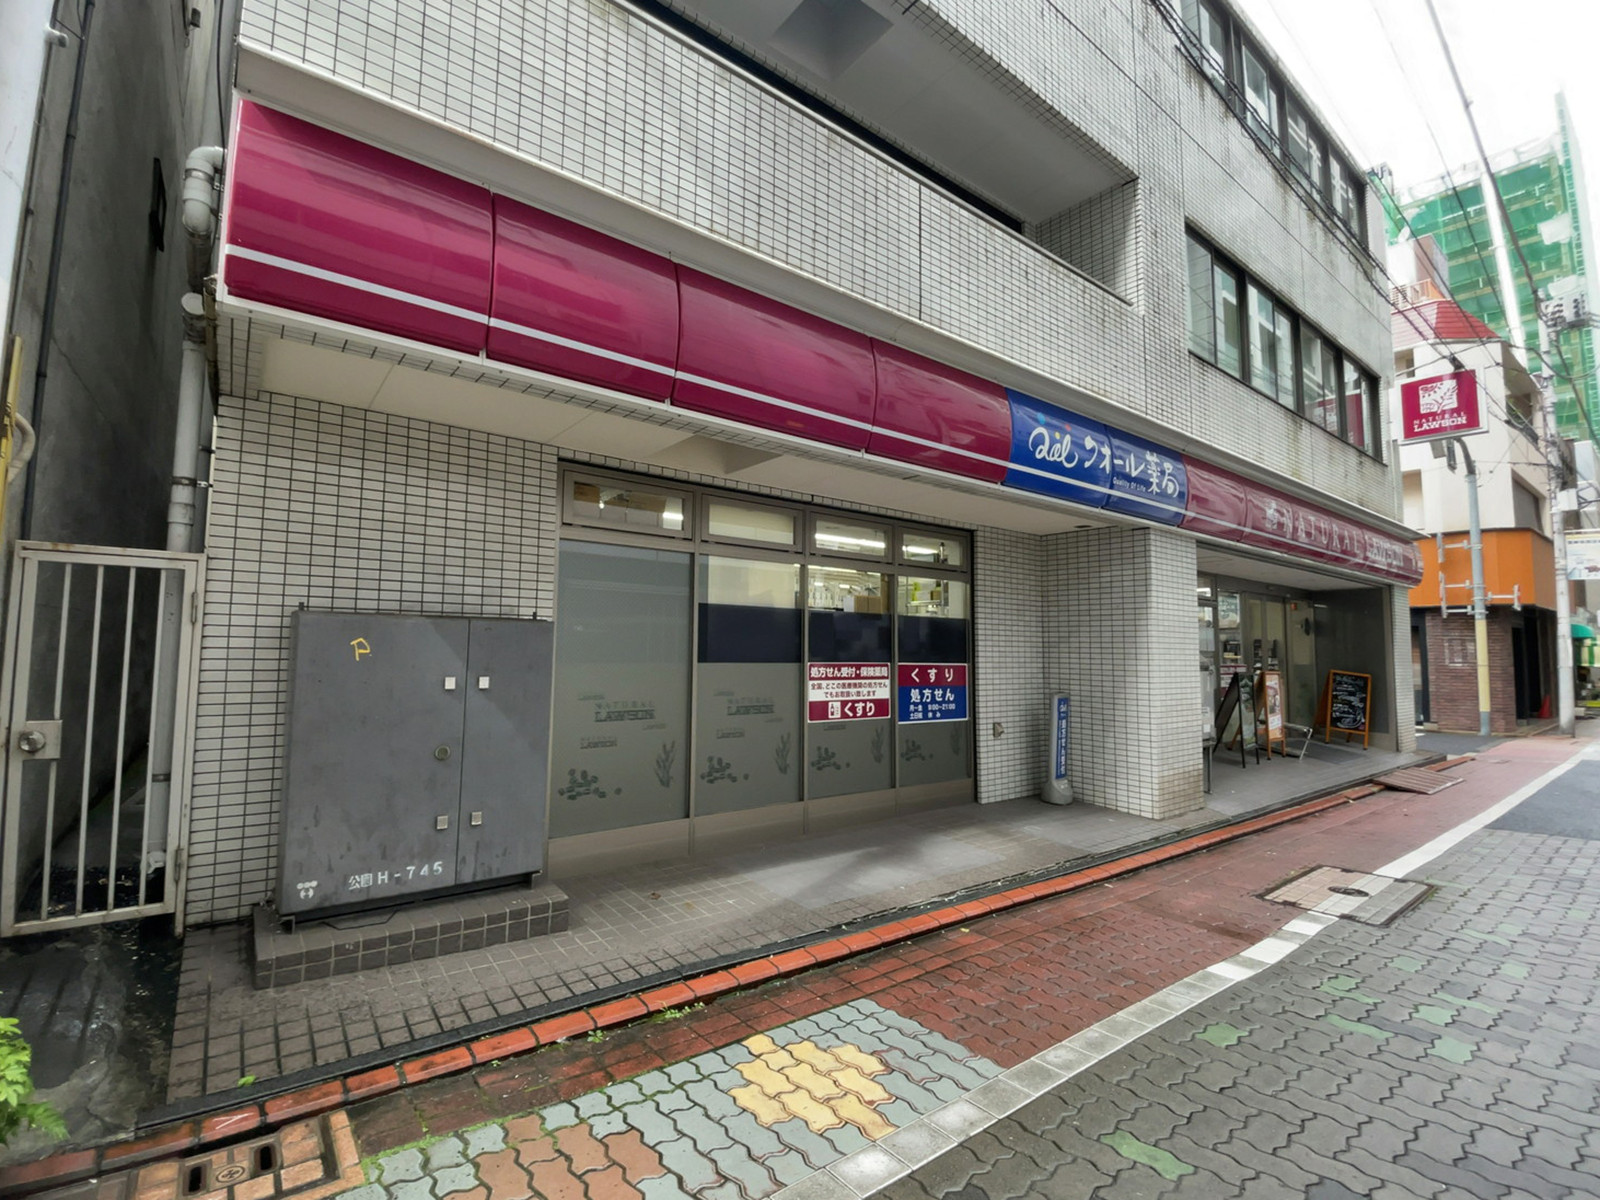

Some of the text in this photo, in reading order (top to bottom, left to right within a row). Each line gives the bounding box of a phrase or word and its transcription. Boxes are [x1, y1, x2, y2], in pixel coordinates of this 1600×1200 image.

[1413, 411, 1465, 425] NATURAL
[1413, 416, 1467, 432] LAWSON
[1282, 507, 1361, 555] NATURAL
[911, 667, 954, 683] くすり
[910, 688, 955, 703] 処方せん
[844, 701, 875, 717] くすり
